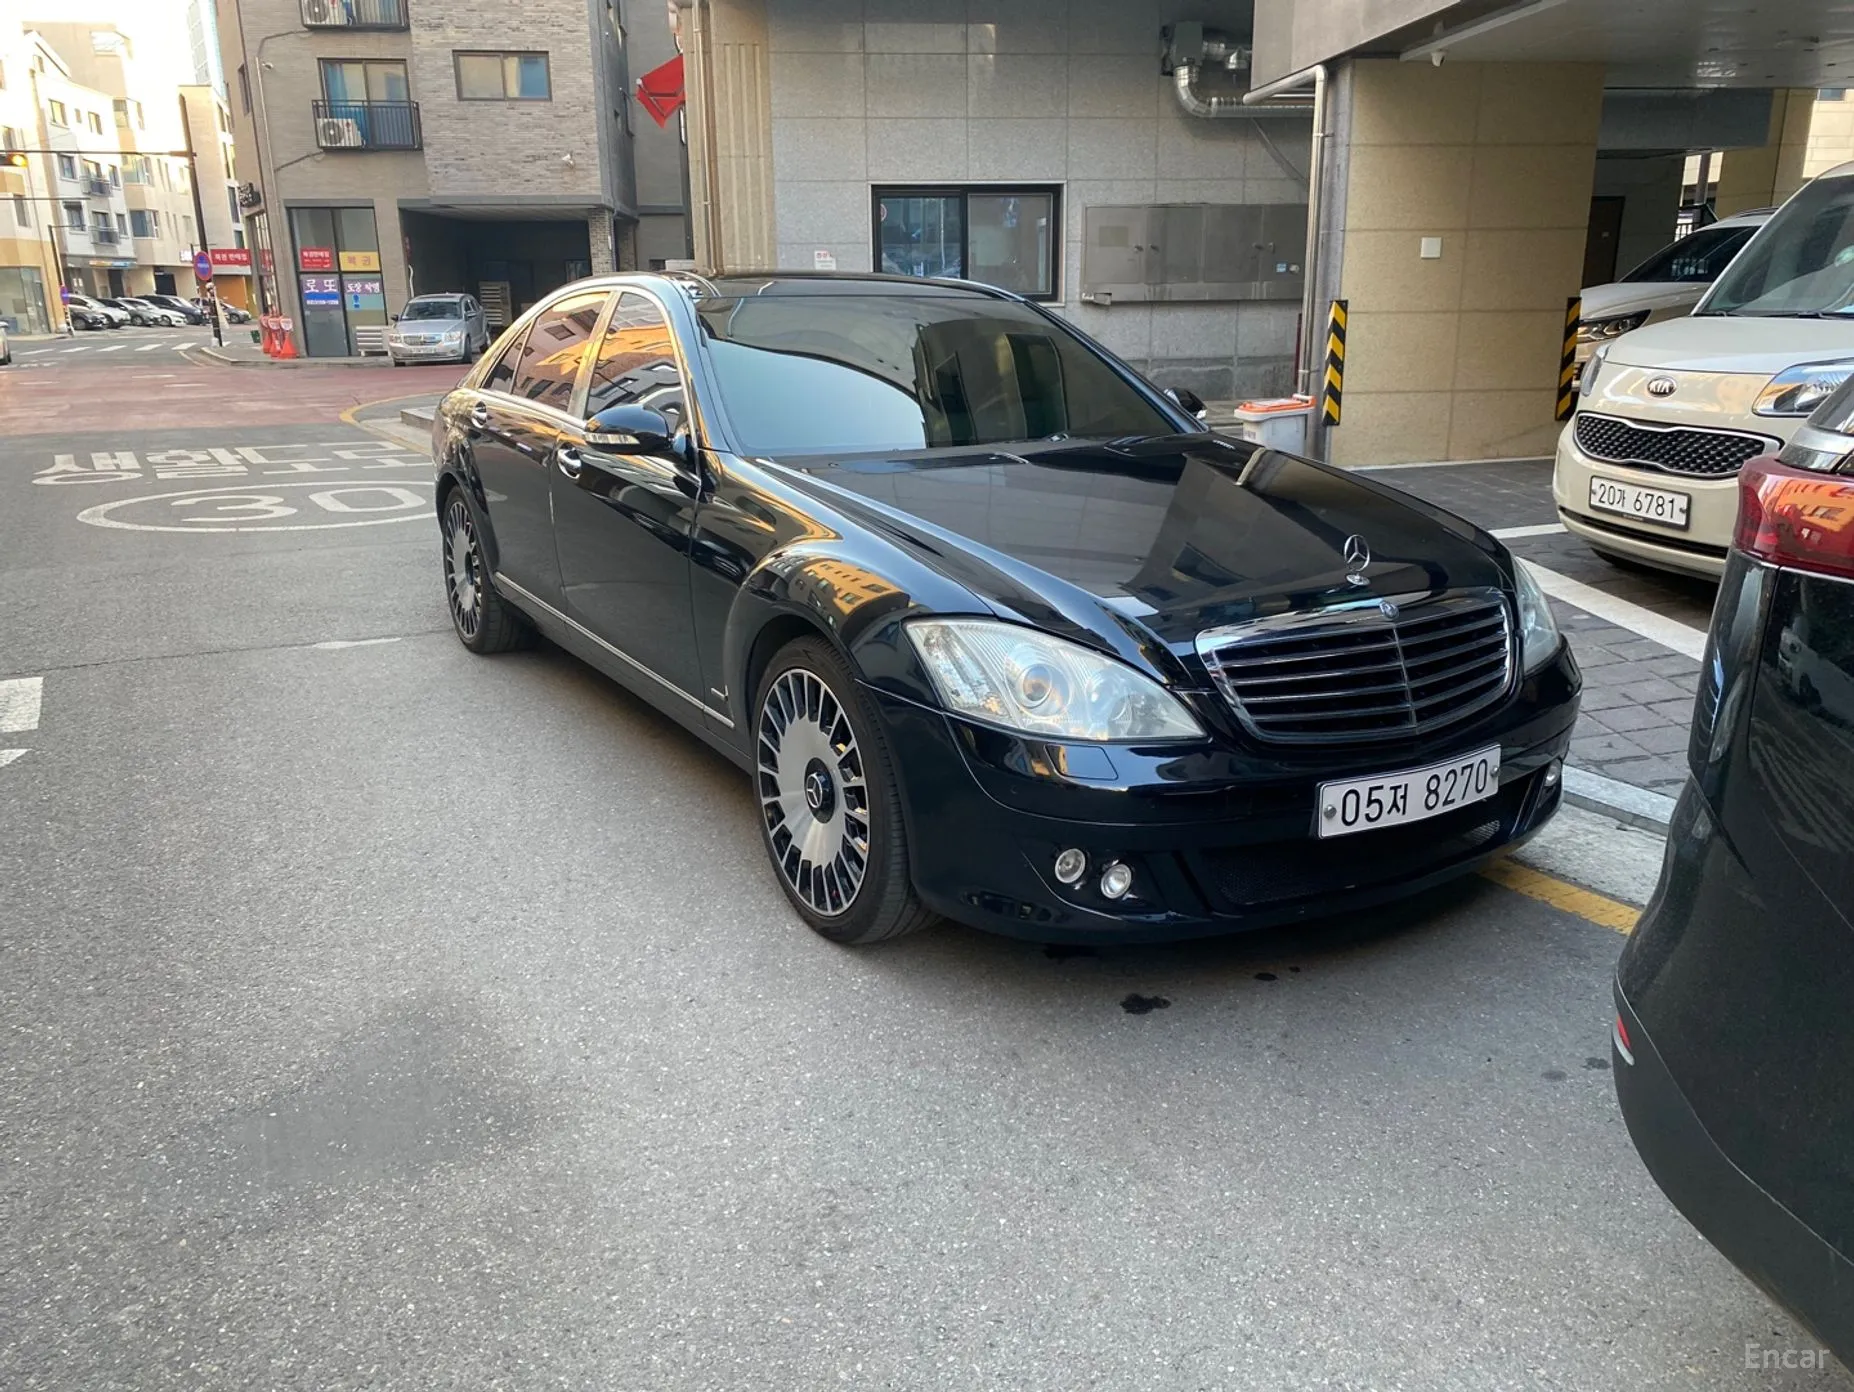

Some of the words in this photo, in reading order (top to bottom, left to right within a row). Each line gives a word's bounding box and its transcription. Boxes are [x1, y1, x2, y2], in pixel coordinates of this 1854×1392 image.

[1649, 383, 1670, 394] KIA
[170, 486, 428, 523] 30
[1598, 483, 1626, 508] 20가
[1633, 491, 1676, 519] 6781
[1341, 782, 1409, 827] 05저
[1424, 758, 1488, 811] 8270
